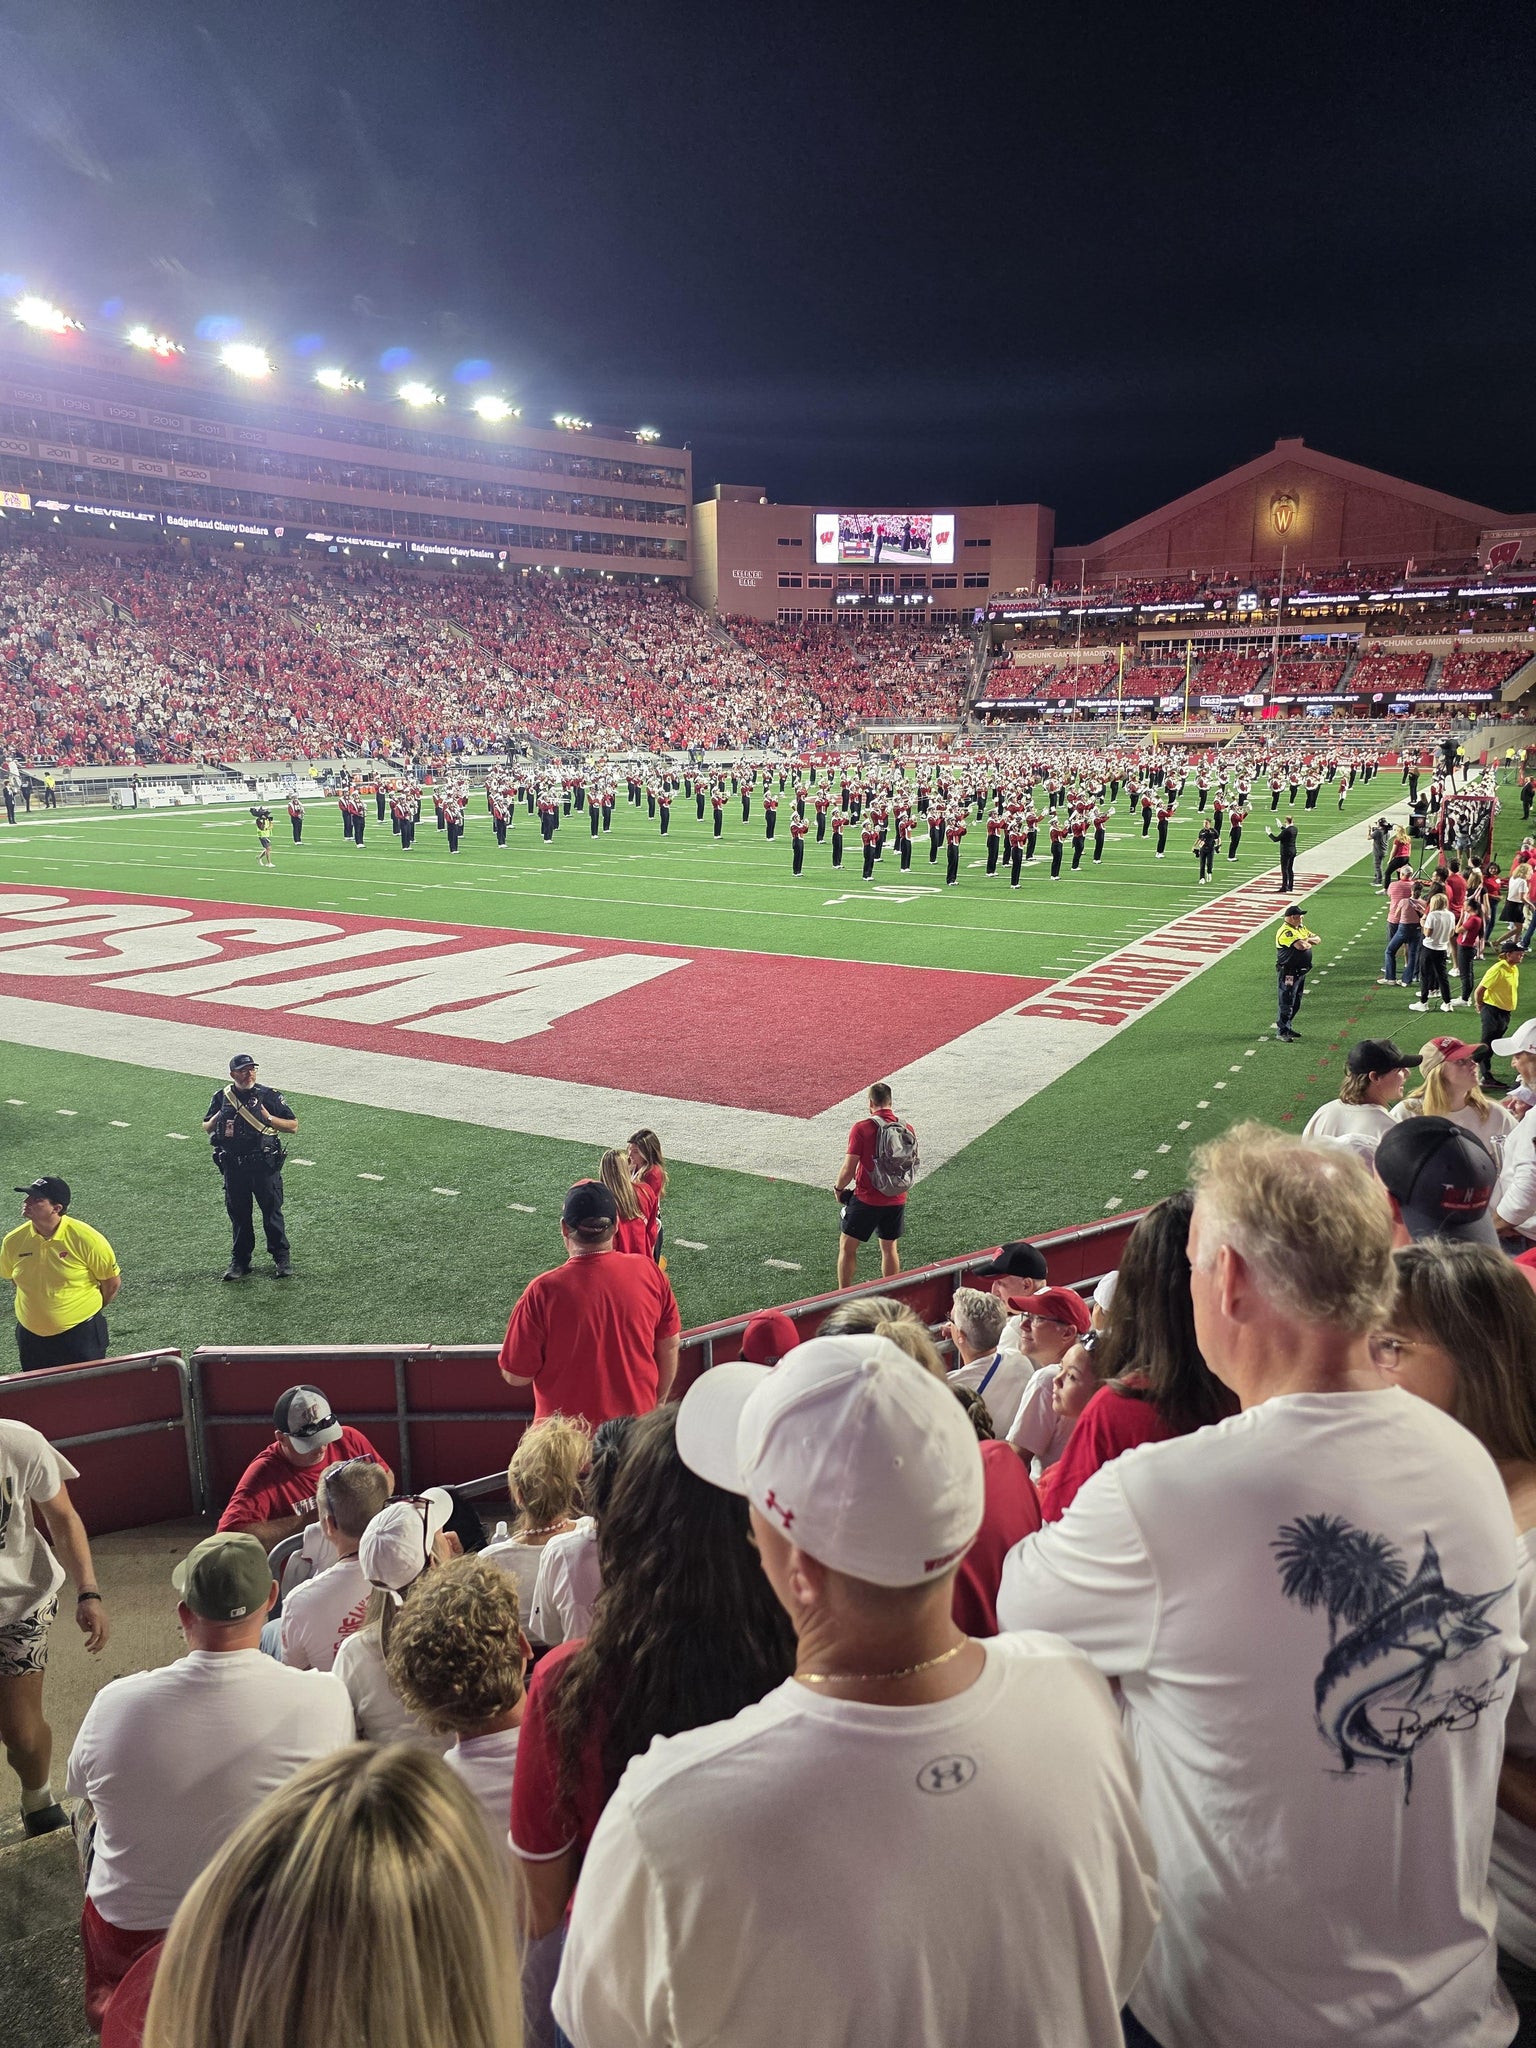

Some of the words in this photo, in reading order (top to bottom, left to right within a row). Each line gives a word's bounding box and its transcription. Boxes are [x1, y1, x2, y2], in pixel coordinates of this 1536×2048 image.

[63, 399, 90, 411] 1998
[109, 407, 136, 419] 1999
[153, 416, 180, 427] 2010
[198, 424, 220, 434] 2011
[240, 432, 262, 441] 2012
[0, 441, 28, 452] 000
[47, 448, 71, 459] 2011
[92, 455, 119, 466] 2012
[138, 462, 162, 473] 2013
[180, 469, 207, 479] 2020
[74, 504, 156, 522] CHEVROLET
[167, 515, 213, 530] Badgerland
[214, 521, 238, 534] Chevy
[239, 524, 269, 536] Dealers
[336, 536, 401, 549] CHEVROLET
[411, 543, 449, 554] Badgerland
[1237, 594, 1257, 610] 25
[1368, 638, 1414, 648] HO-CHUNK
[1415, 637, 1451, 646] GAMING
[1454, 635, 1505, 645] WISCONSIN
[1507, 634, 1535, 643] DELLS
[1016, 651, 1052, 660] HO-CHUNK
[1013, 952, 1206, 1027] BARRY
